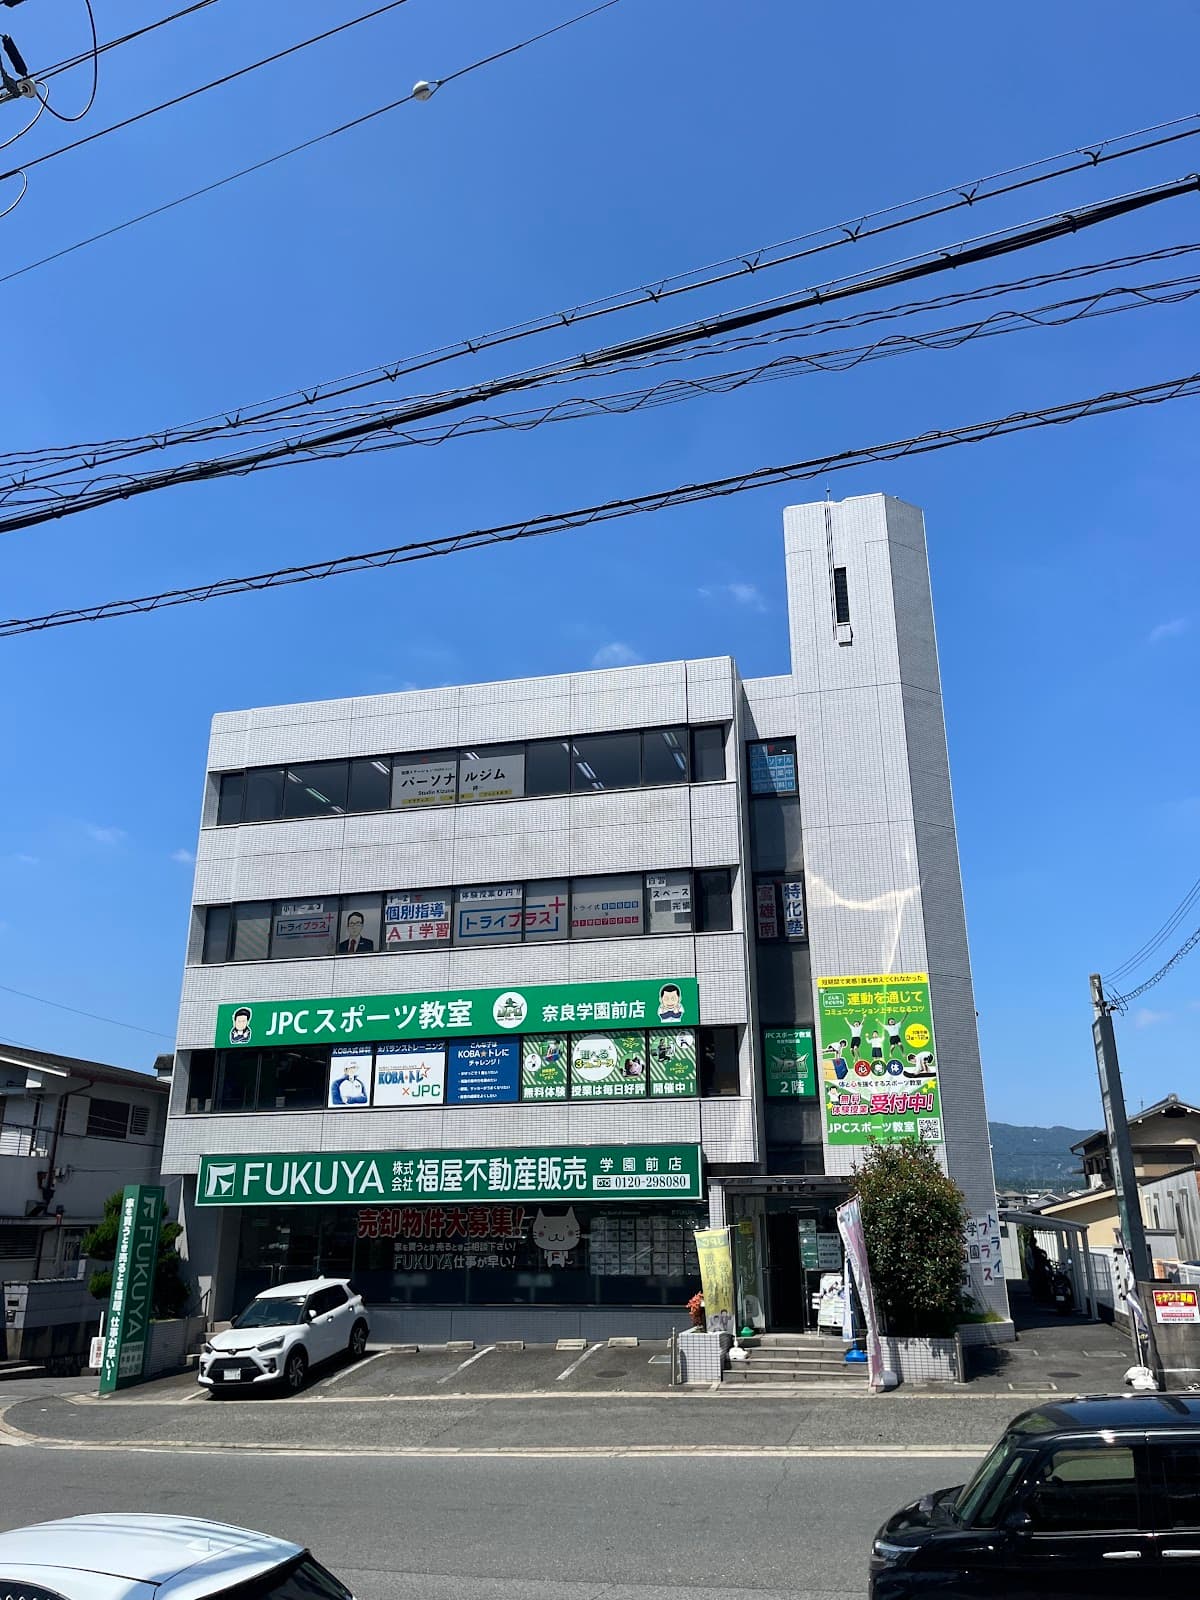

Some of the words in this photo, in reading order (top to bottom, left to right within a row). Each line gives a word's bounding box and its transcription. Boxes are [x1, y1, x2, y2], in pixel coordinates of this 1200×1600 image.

[652, 888, 689, 898] スペース
[386, 903, 444, 921] 個別指導
[784, 883, 804, 935] 特化塾
[280, 921, 327, 932] トライプラス
[466, 911, 552, 930] トライプラス
[388, 922, 450, 941] AI学習
[847, 991, 923, 1006] 運動を通じて
[265, 999, 474, 1036] JPCスポーツ教室
[542, 1000, 646, 1022] 奈良学園前店
[825, 1005, 925, 1016] コミュニケーション上手になるコツ
[411, 1084, 441, 1097] JPC
[523, 1086, 566, 1098] 無料体験
[571, 1083, 646, 1096] 授業は毎日好評
[780, 1080, 805, 1094] 2階
[839, 1094, 861, 1105] 無料
[870, 1092, 934, 1115] 受付中!
[828, 1121, 916, 1134] JPCスポーツ教室
[392, 1160, 414, 1176] 株式
[600, 1156, 682, 1172] 学園前店
[242, 1159, 385, 1196] FUKUYA
[416, 1156, 588, 1192] 福屋不動産販売
[615, 1175, 687, 1188] 0120-298080
[391, 1178, 413, 1192] 会社
[357, 1207, 526, 1239] 売却物件大募集!
[987, 1214, 1001, 1273] トライ
[126, 1225, 154, 1339] FUKUYA
